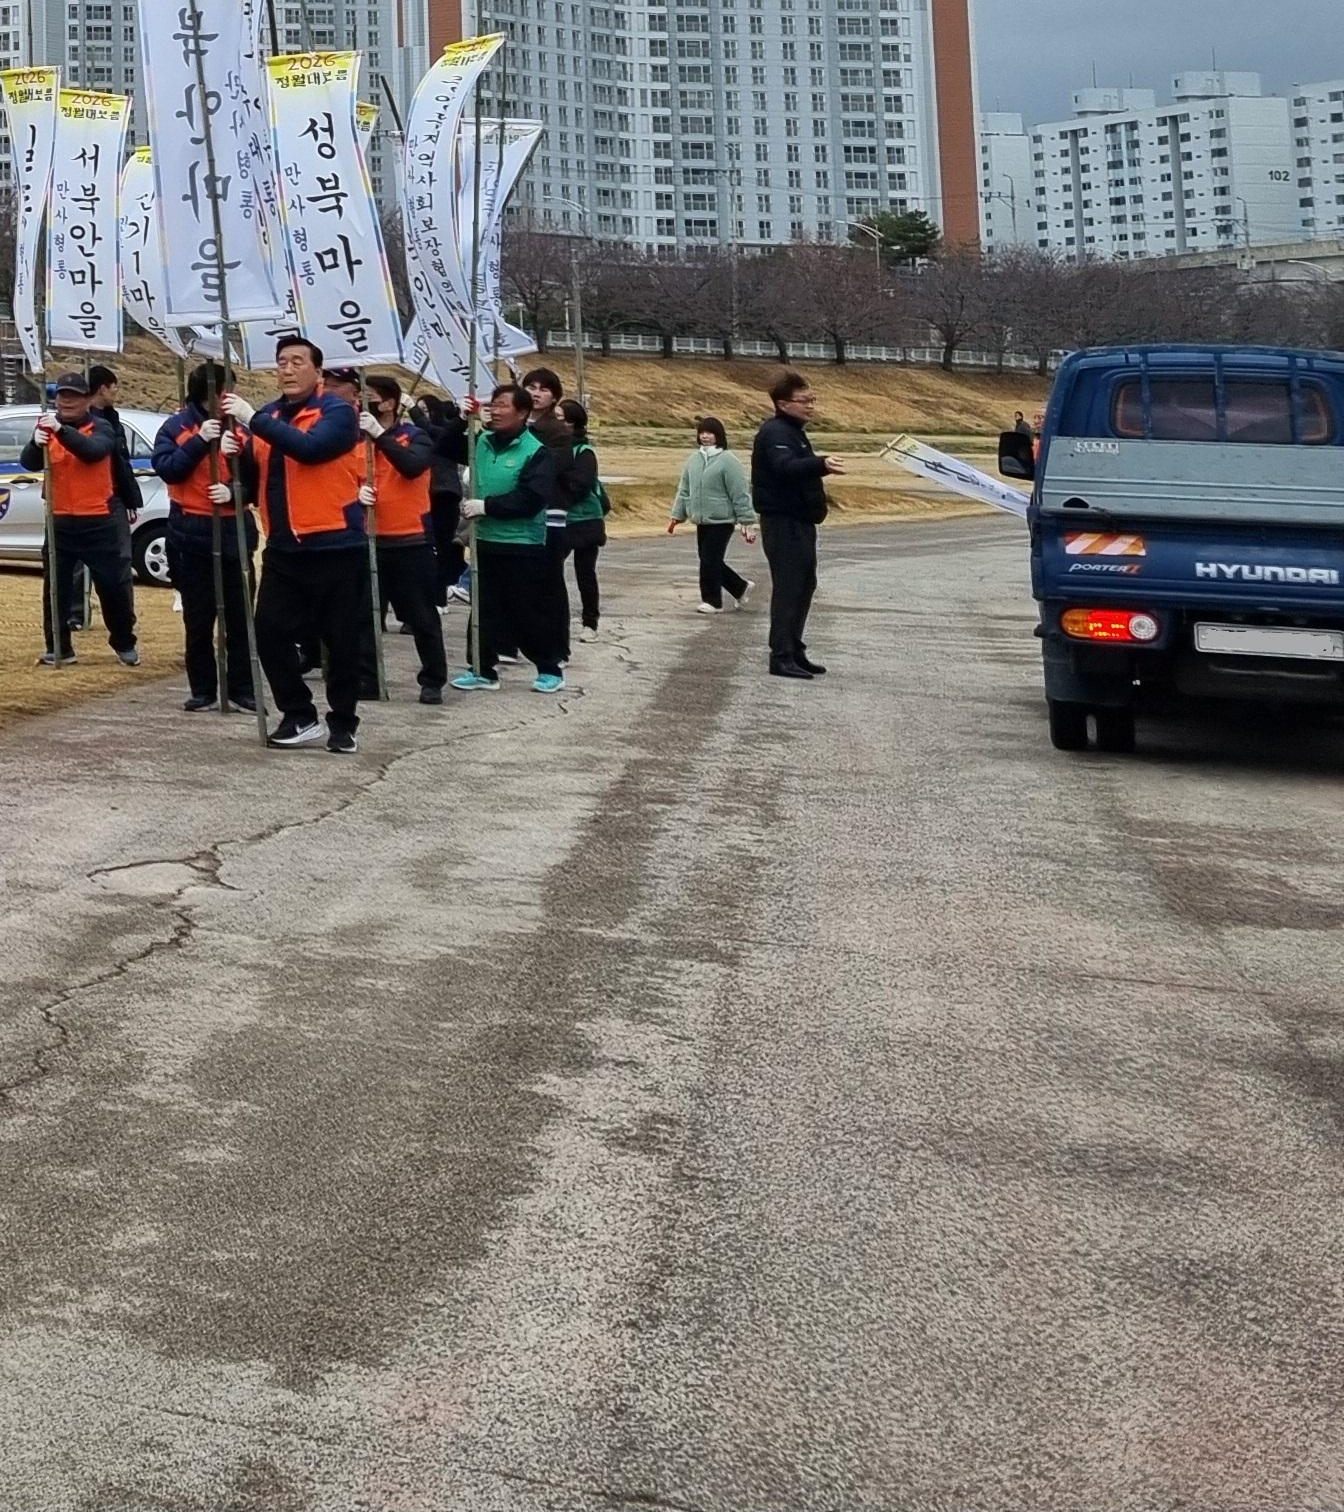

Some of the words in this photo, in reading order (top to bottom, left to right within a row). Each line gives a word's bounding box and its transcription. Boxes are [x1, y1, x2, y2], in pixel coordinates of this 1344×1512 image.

[287, 55, 337, 72] 2026
[15, 71, 47, 86] 2026
[275, 69, 348, 89] 정월대보름
[71, 92, 113, 107] 2026
[60, 106, 121, 122] 정월대보름
[1268, 170, 1291, 182] 102
[54, 179, 70, 281] 만사형통
[283, 161, 317, 286] 만사형통
[298, 111, 373, 354] 성북마을
[67, 142, 104, 340] 서북안마을
[1069, 563, 1127, 573] PORTER
[1195, 561, 1340, 585] HYUNDAI
